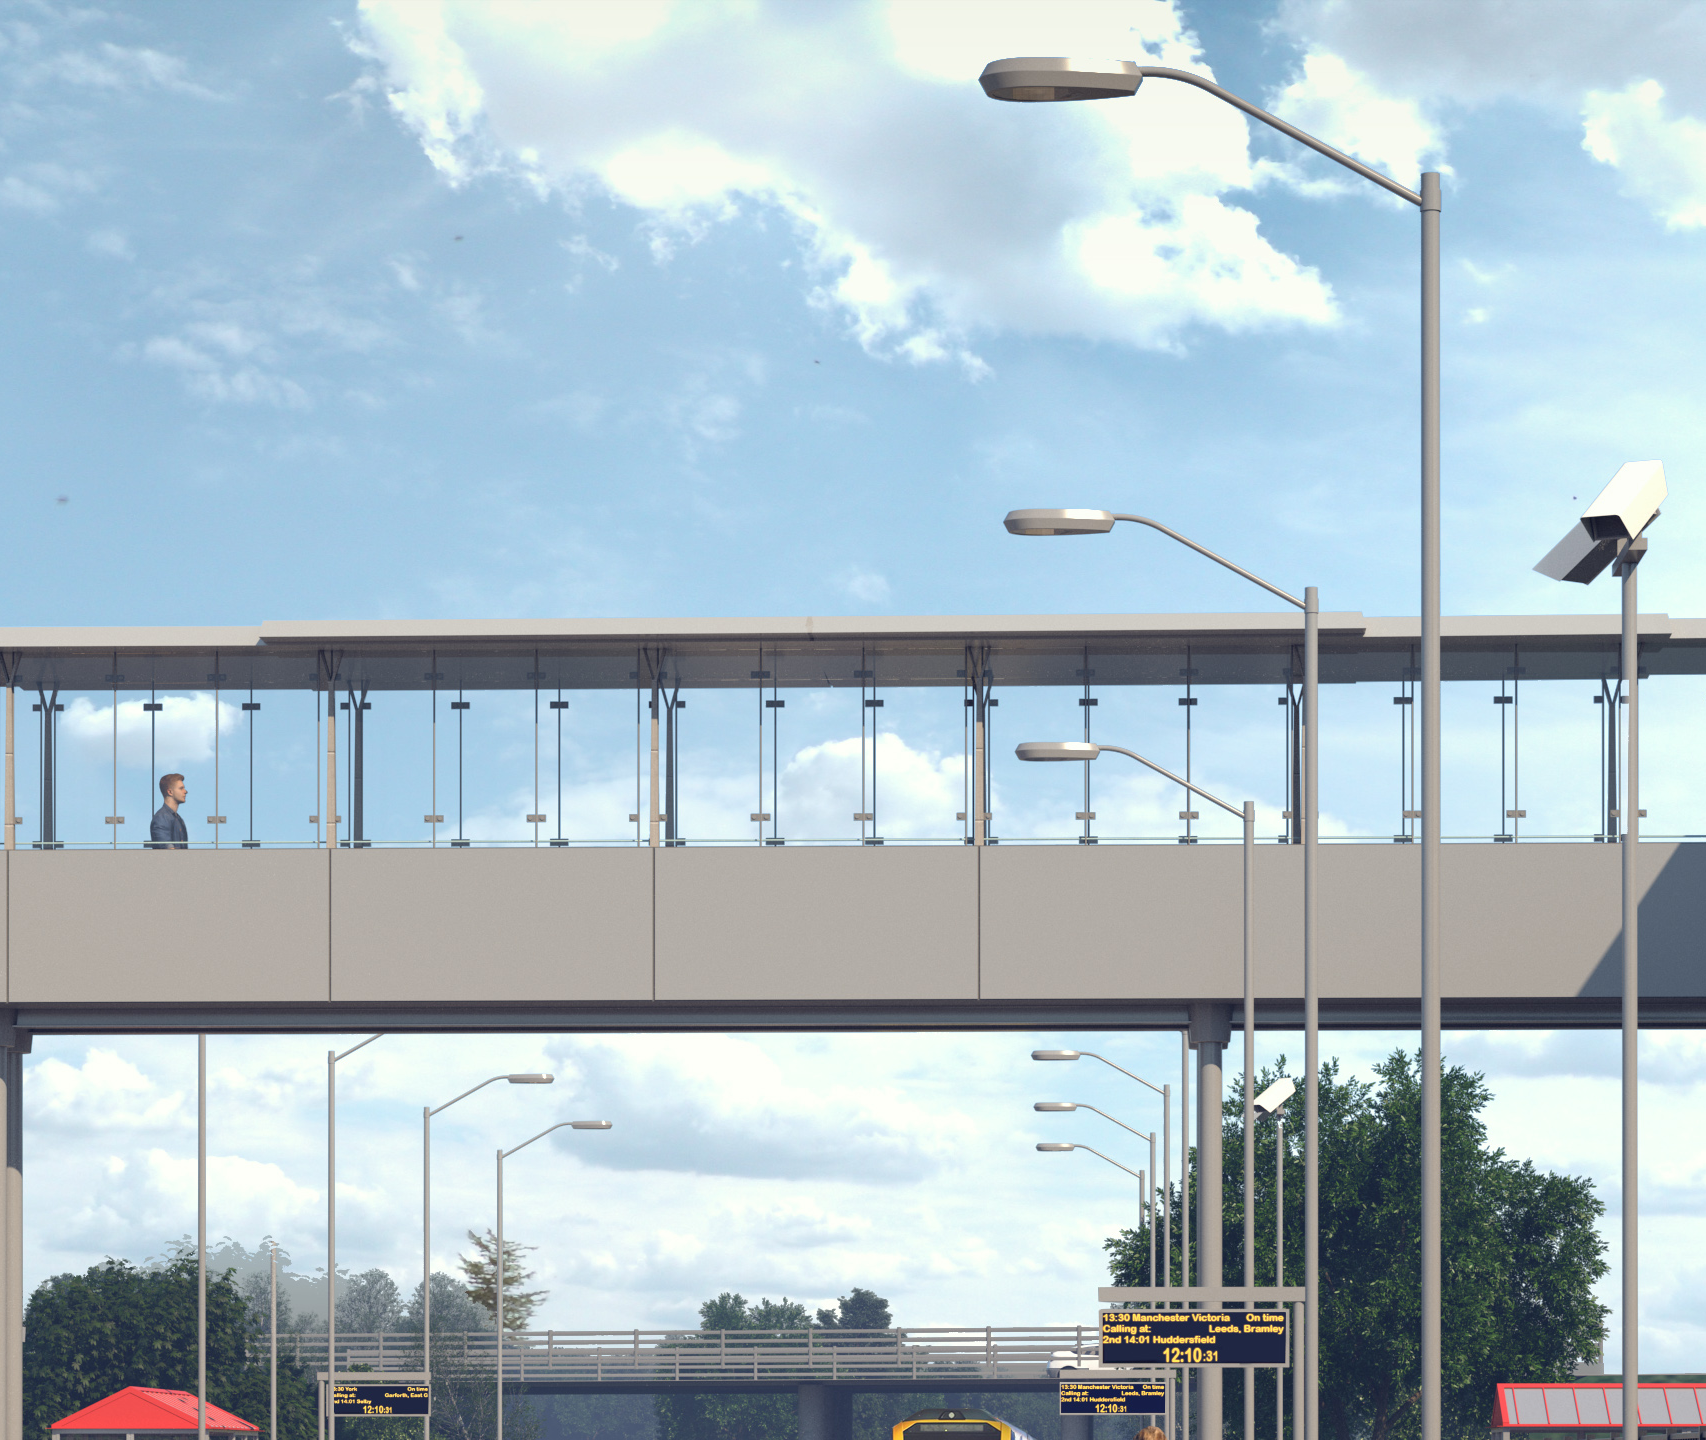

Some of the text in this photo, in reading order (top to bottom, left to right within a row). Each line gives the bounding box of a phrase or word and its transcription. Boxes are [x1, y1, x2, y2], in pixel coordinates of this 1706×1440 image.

[1103, 1314, 1284, 1322] 13:30 Manchester Victoria On time
[1103, 1325, 1284, 1334] Calling at: Leeds, Bramley
[1103, 1336, 1215, 1344] 2nd 14:01 Huddersfield
[1163, 1347, 1218, 1363] 12:10:31
[363, 1405, 392, 1413] 12:10:31
[1095, 1404, 1127, 1413] 12:10:31
